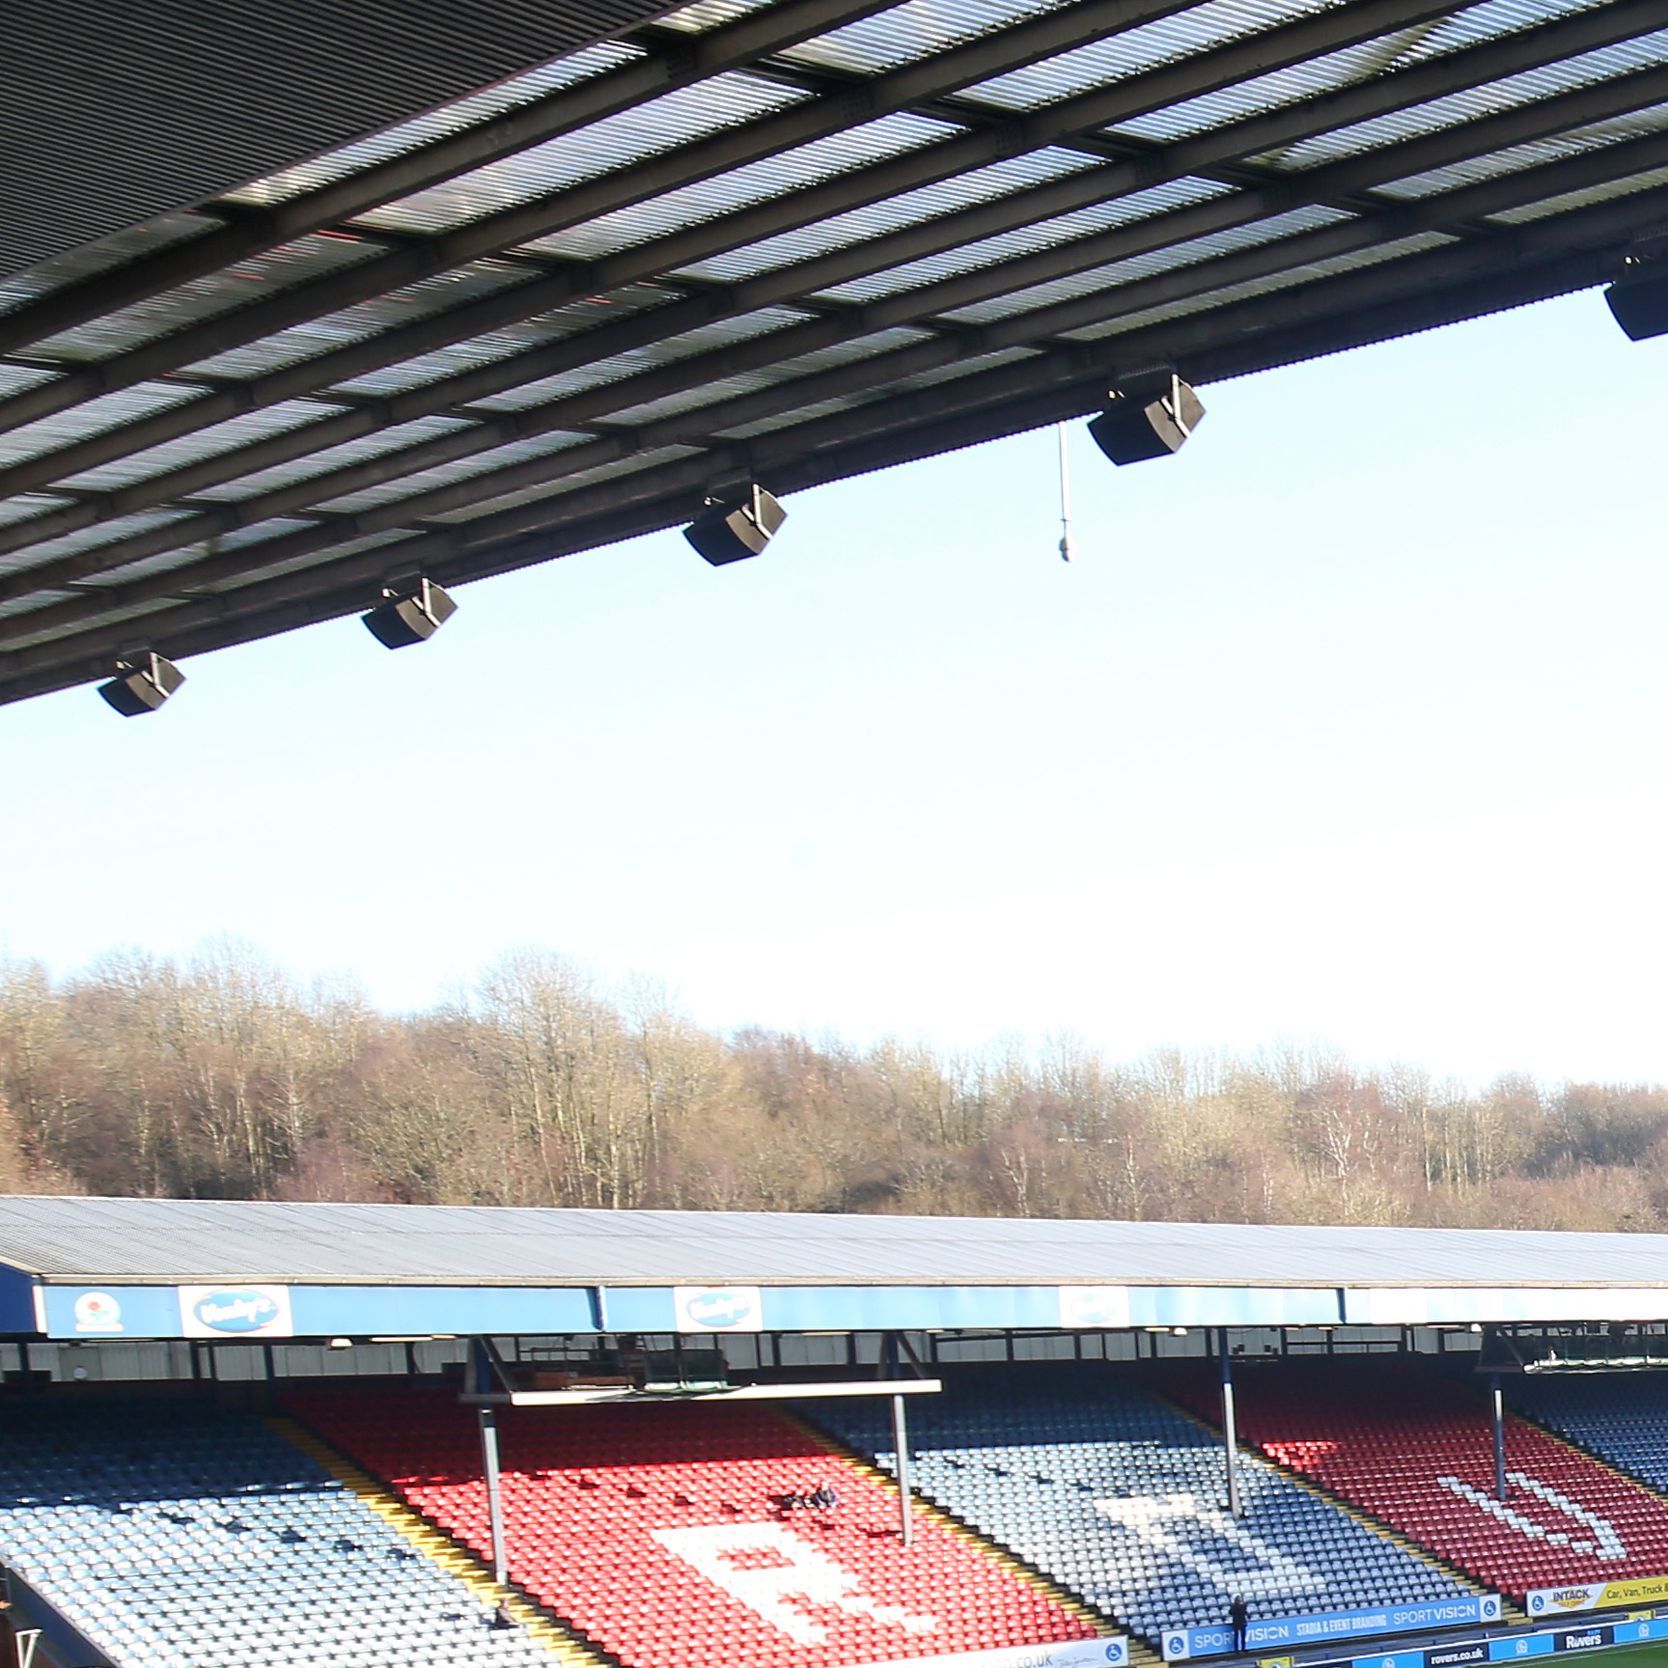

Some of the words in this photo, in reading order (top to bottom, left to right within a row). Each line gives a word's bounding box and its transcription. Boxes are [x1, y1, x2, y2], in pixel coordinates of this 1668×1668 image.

[1552, 1588, 1590, 1601] INTACK
[1606, 1588, 1623, 1600] Car,
[1626, 1586, 1642, 1598] Van,
[1642, 1584, 1662, 1595] Truck
[1393, 1603, 1477, 1626] SPORTVISION
[1297, 1619, 1319, 1636] STADIA
[1328, 1617, 1351, 1633] EVENT
[1352, 1613, 1388, 1630] BRANDING
[1431, 1647, 1484, 1665] rovers.co.uk
